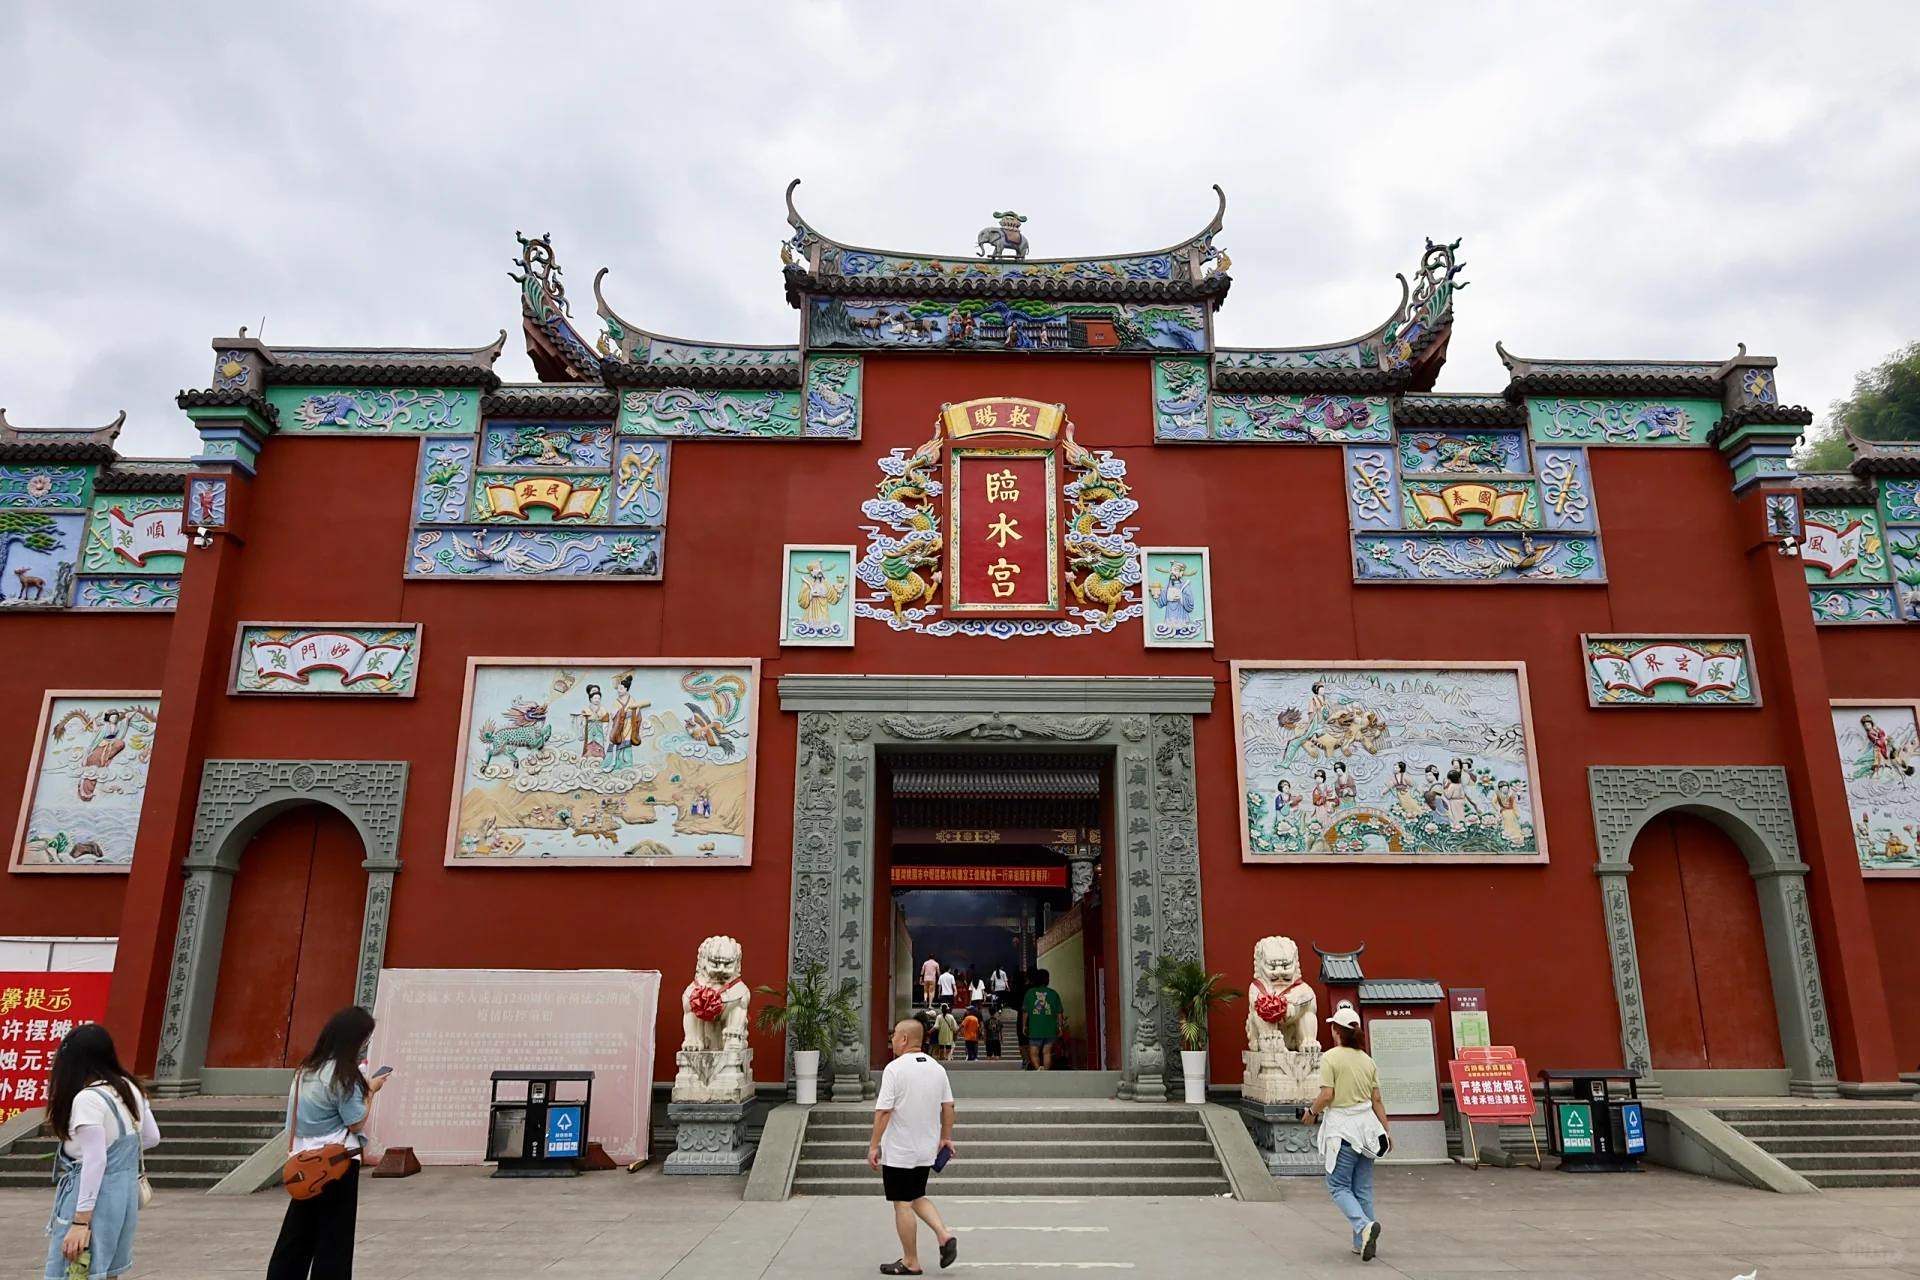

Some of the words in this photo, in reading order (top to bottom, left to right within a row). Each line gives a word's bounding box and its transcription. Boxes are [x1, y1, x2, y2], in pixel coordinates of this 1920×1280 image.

[2, 1019, 94, 1042] 许摆摊
[1460, 1080, 1525, 1094] 严禁燃放烟花
